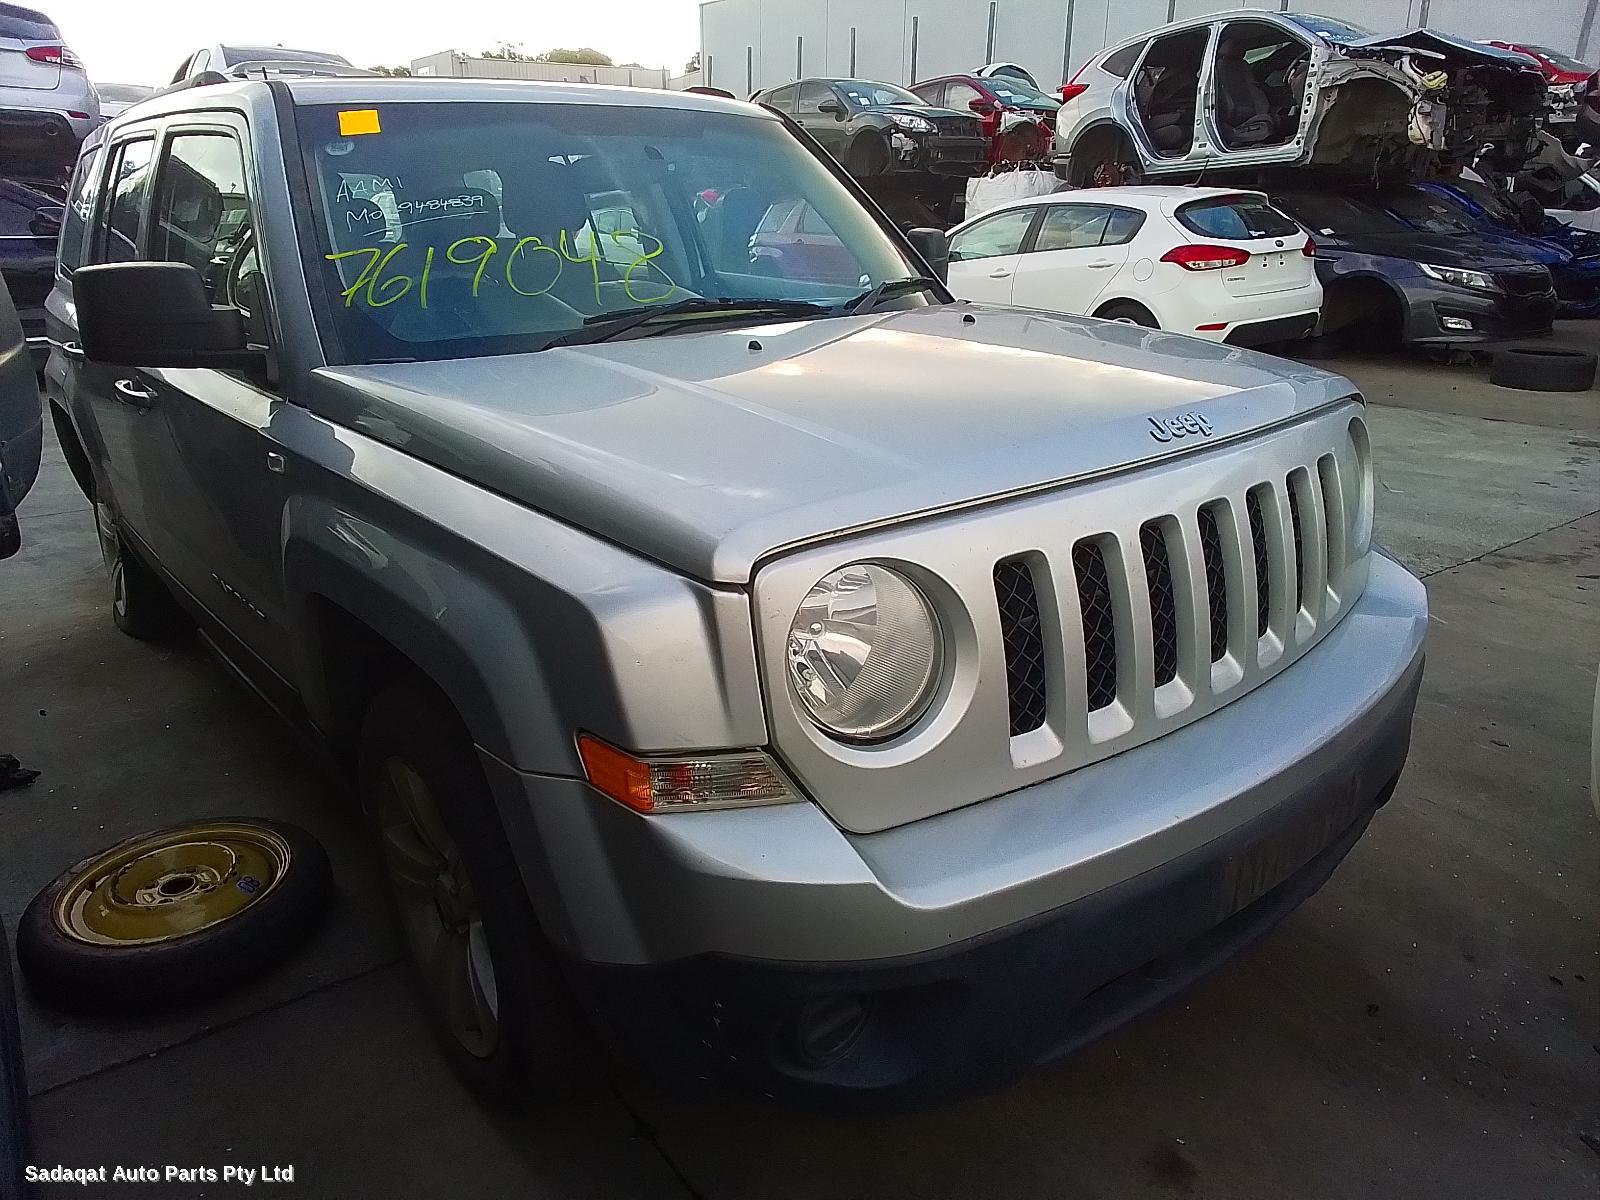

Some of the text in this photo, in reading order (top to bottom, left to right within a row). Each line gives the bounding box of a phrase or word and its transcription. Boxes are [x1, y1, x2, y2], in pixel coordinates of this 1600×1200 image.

[336, 176, 403, 203] AAMI
[325, 228, 677, 309] 7619048
[1147, 412, 1213, 443] Jeep
